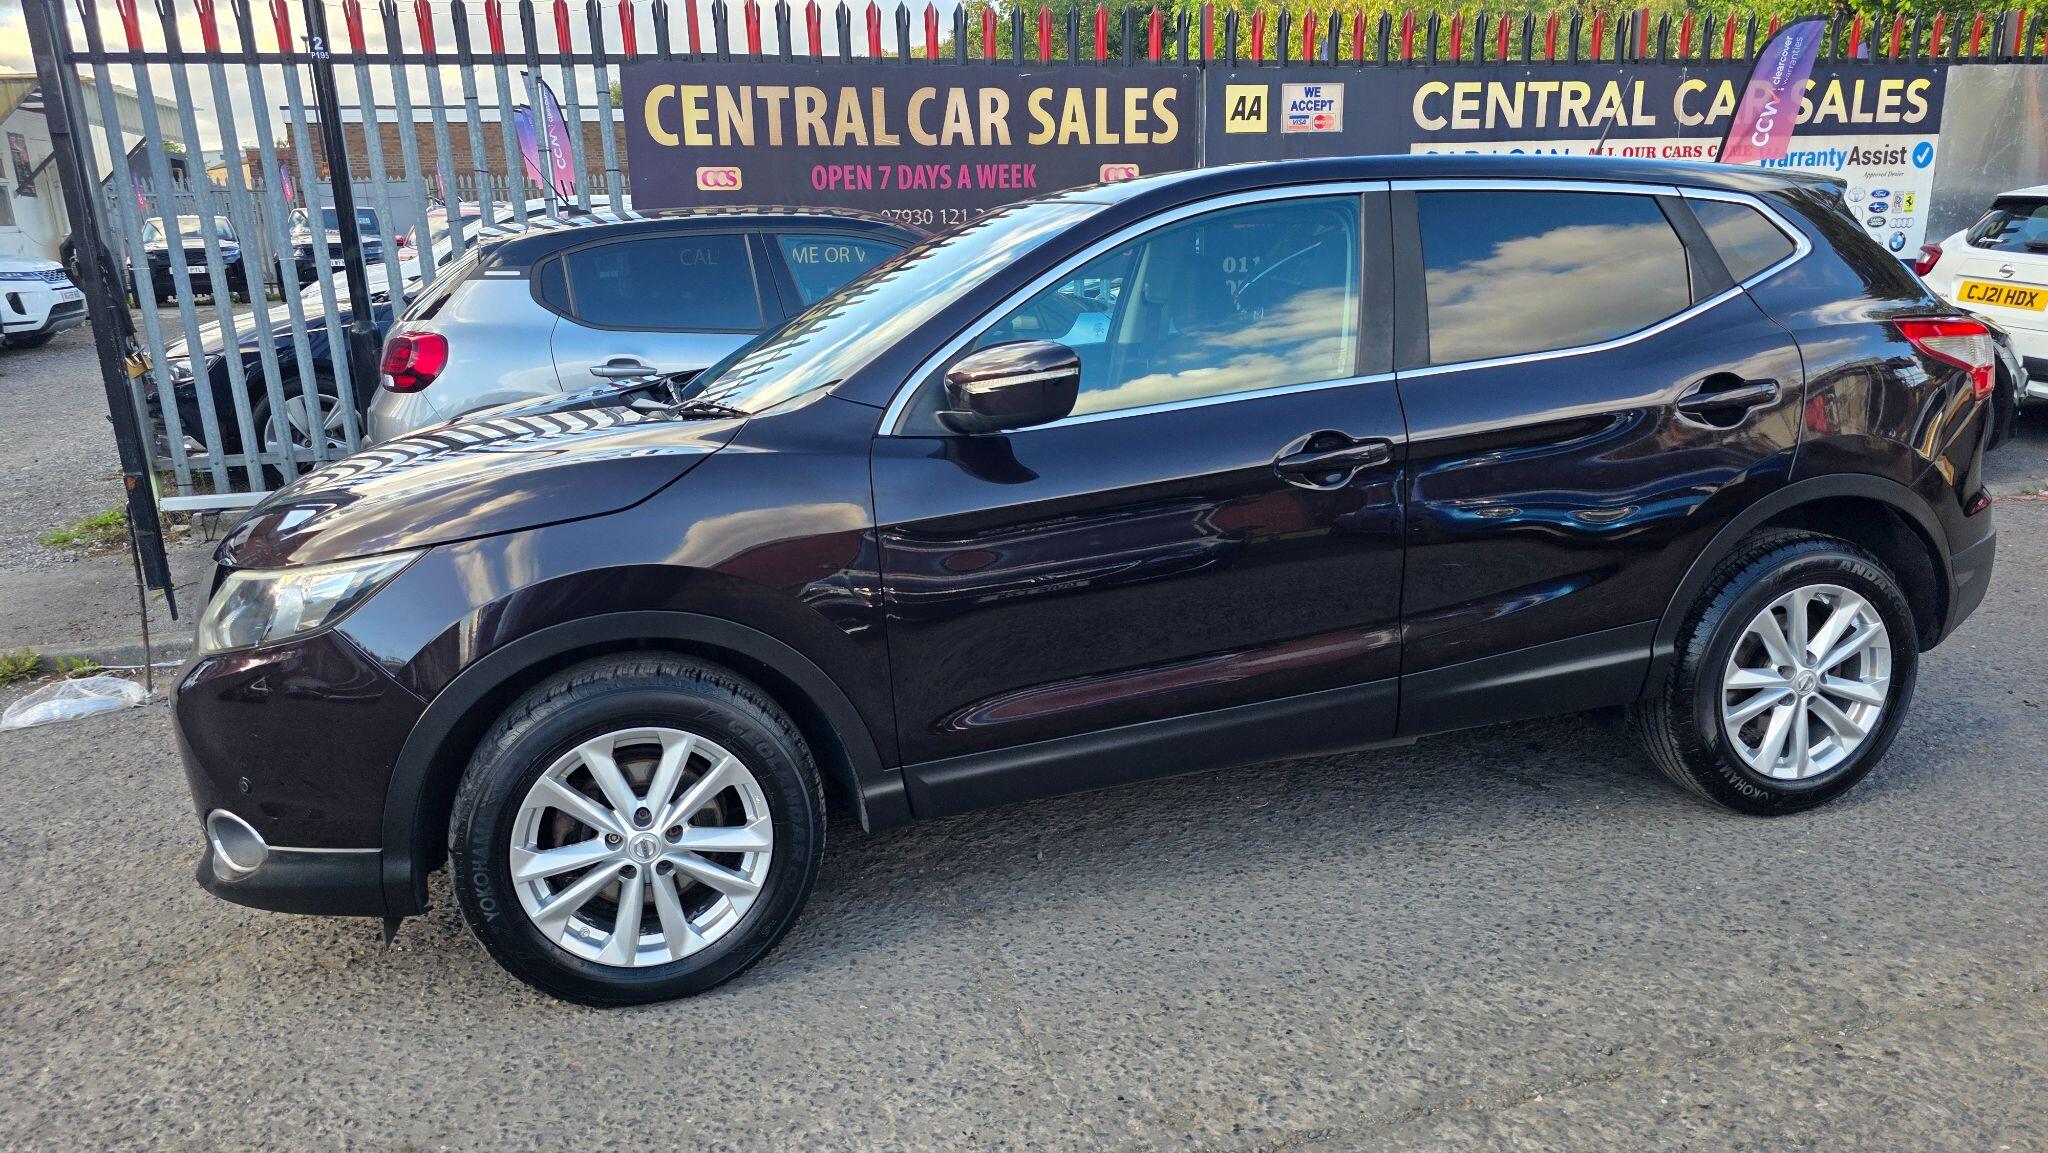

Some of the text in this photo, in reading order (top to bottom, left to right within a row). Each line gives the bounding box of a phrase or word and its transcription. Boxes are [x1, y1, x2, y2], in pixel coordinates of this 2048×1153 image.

[312, 36, 324, 51] 2
[1773, 35, 1793, 85] clearcover
[1783, 36, 1804, 84] warranties
[1304, 86, 1321, 98] WE
[644, 84, 1179, 146] CENTRAL CAR SALES
[1230, 95, 1262, 121] AA
[1290, 100, 1334, 112] ACCEPT
[1412, 80, 1656, 131] CENTRAL
[1791, 78, 1932, 126] SALES
[1622, 147, 1657, 158] OUR
[1662, 145, 1701, 158] CARS
[701, 169, 738, 188] CCS
[811, 163, 1037, 191] OPEN 7 DAYS A WEEK
[940, 208, 968, 225] 121
[825, 246, 850, 263] OR
[1966, 284, 2039, 307] CJ21 HDX
